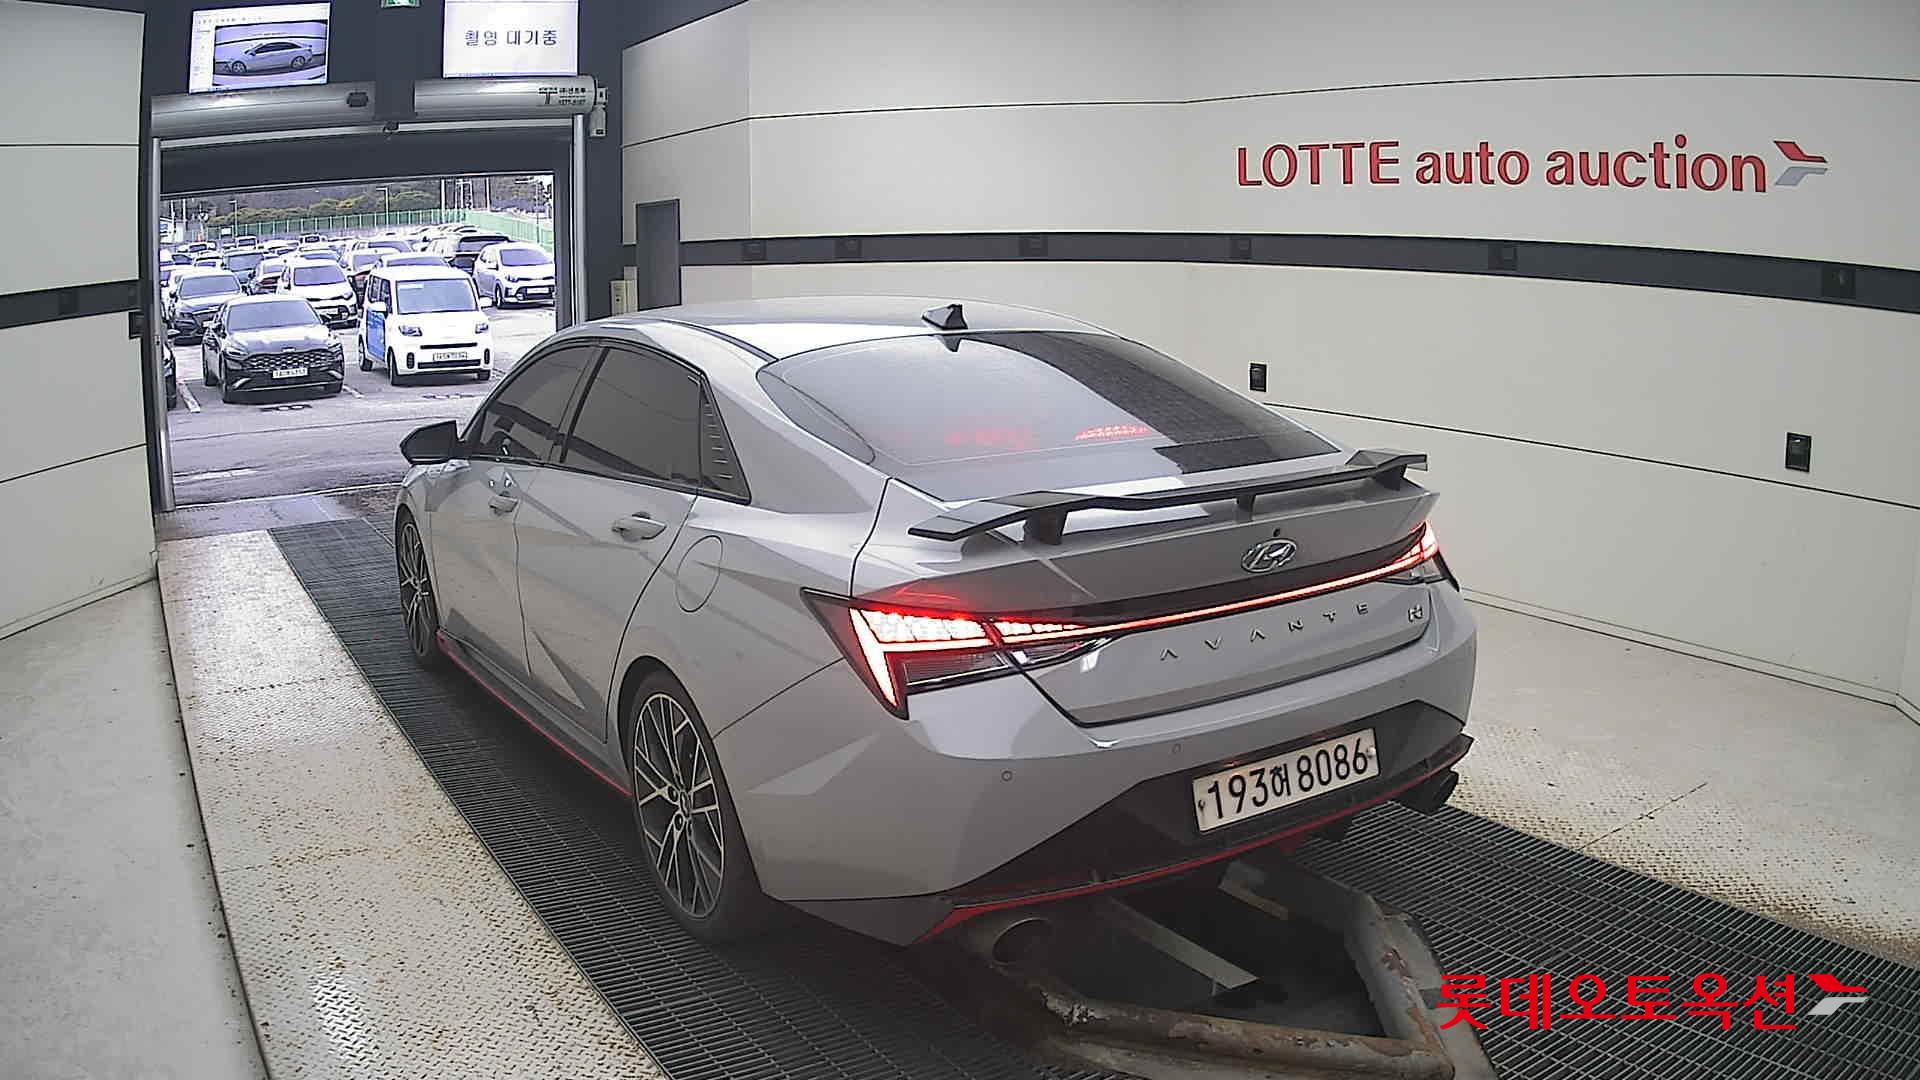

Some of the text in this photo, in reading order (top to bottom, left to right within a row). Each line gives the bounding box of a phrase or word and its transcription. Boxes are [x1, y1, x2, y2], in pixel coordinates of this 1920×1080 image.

[506, 30, 557, 46] 대기중
[1237, 134, 1768, 193] LOTTE auto auction
[1159, 603, 1369, 661] AVANTE
